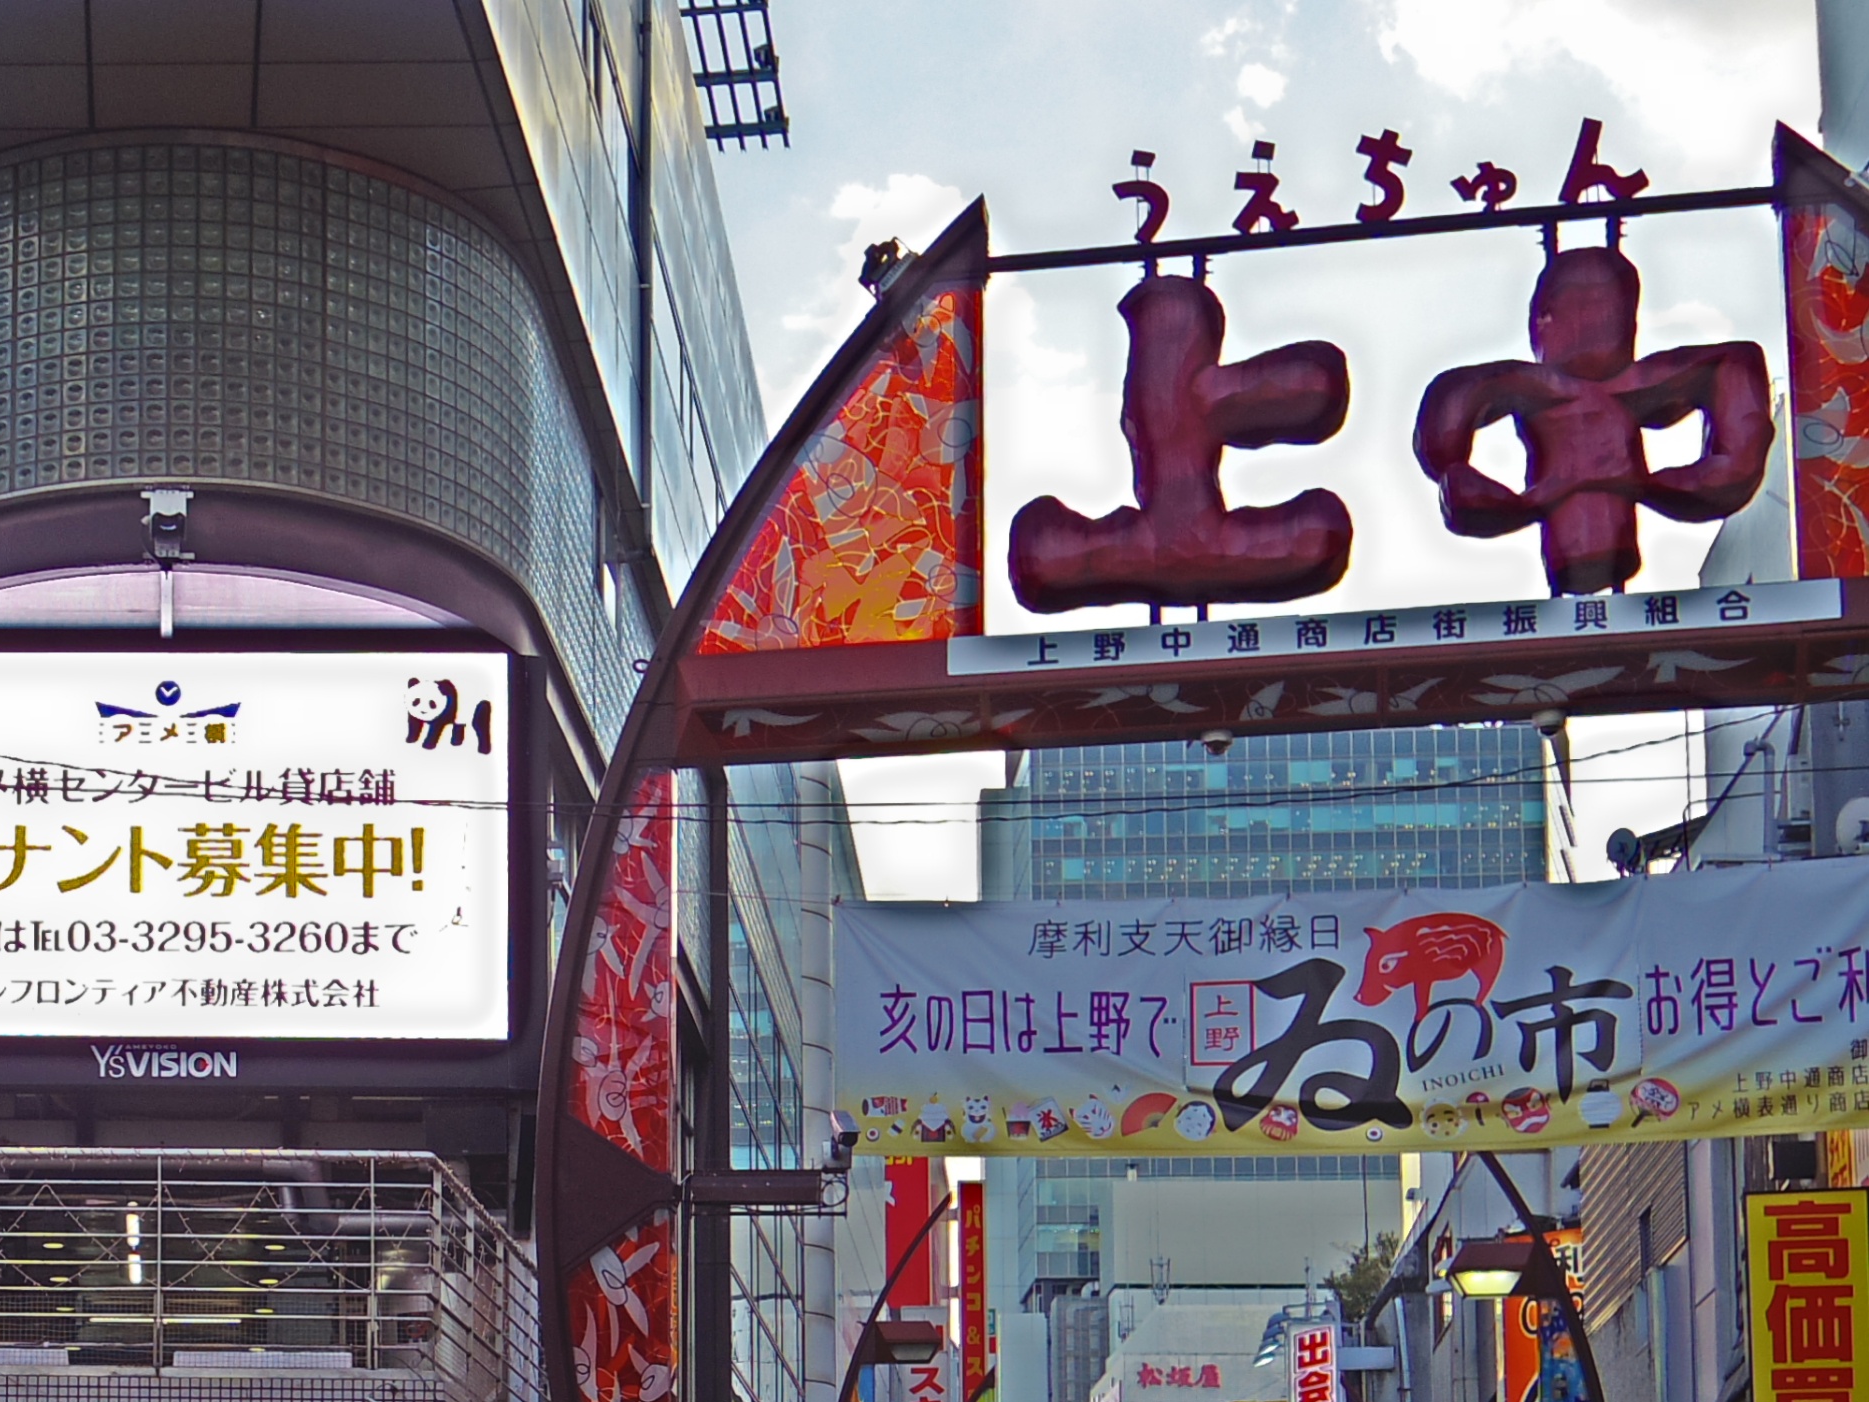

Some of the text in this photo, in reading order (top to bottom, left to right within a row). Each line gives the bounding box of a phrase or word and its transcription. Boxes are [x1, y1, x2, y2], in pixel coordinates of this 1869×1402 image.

[1111, 118, 1650, 244] うえちゅん
[1007, 246, 1777, 616] 上中
[1027, 590, 1752, 668] 上野中通商店街振興組合
[1028, 914, 1340, 958] 摩利支天御縁日
[879, 984, 1177, 1058] 亥の日は上野で
[1204, 994, 1241, 1051] 上野
[1422, 1063, 1506, 1092] INOICHI
[965, 1204, 984, 1398] パチンコ&ス
[1137, 1362, 1222, 1390] 松坂屋
